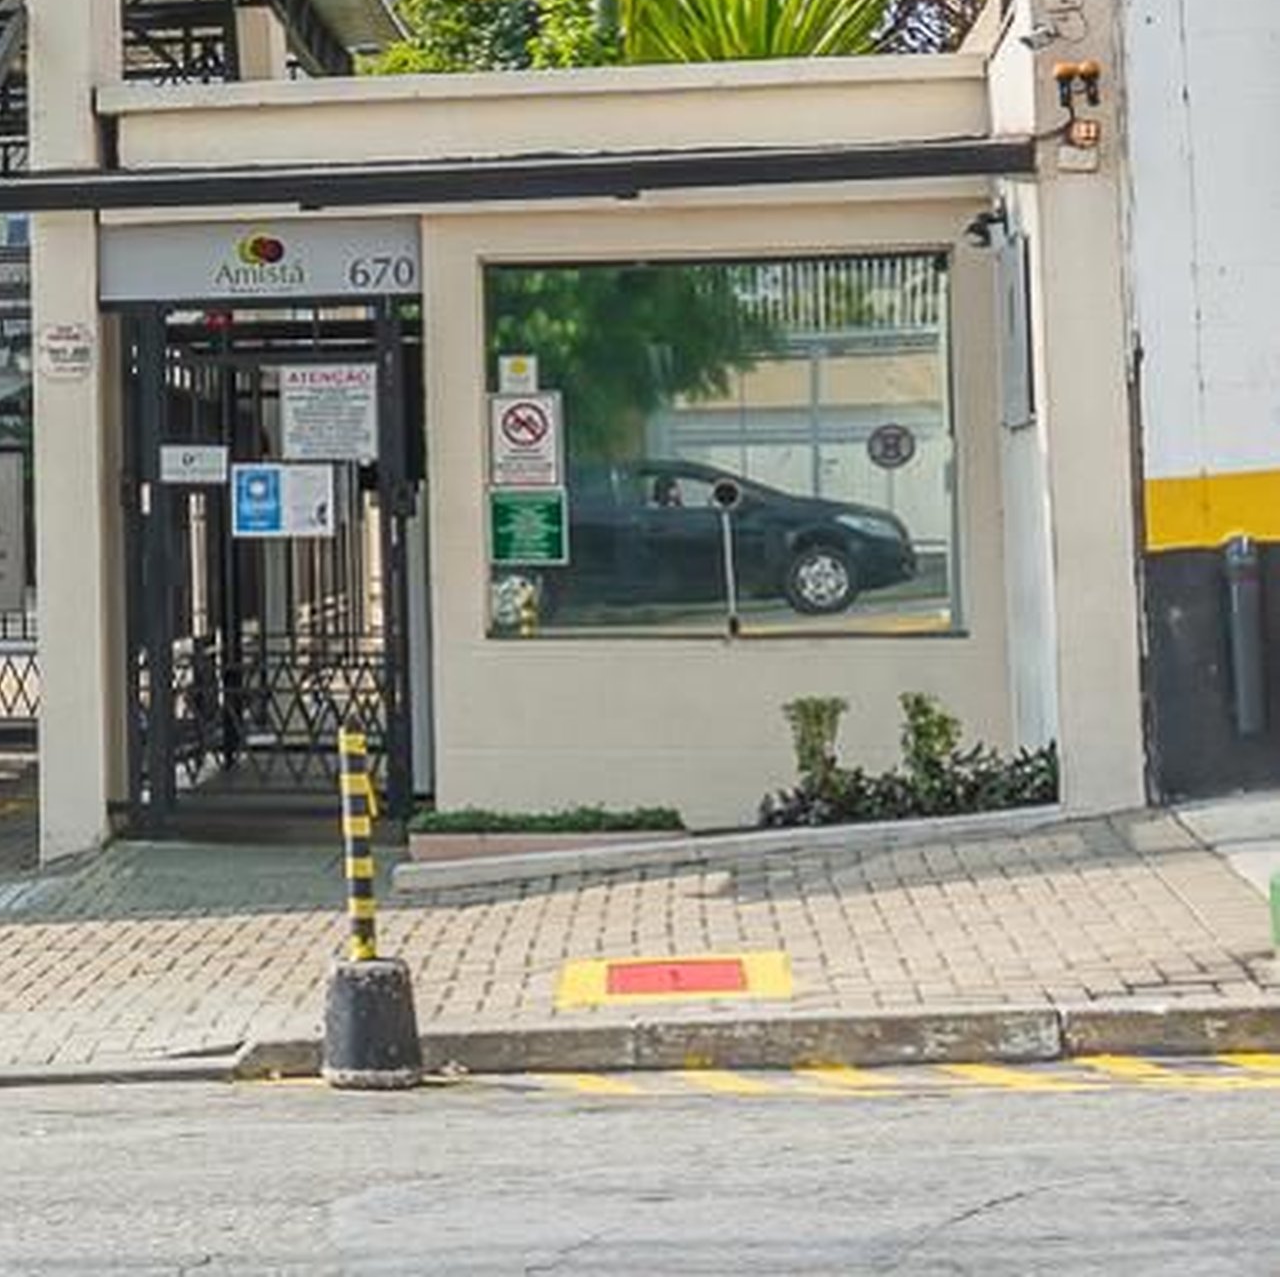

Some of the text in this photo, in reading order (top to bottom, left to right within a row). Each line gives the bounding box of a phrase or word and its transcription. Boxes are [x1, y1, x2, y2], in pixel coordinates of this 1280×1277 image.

[214, 259, 305, 285] Amistá
[349, 256, 415, 288] 670
[287, 369, 371, 386] ATENÇÃO
